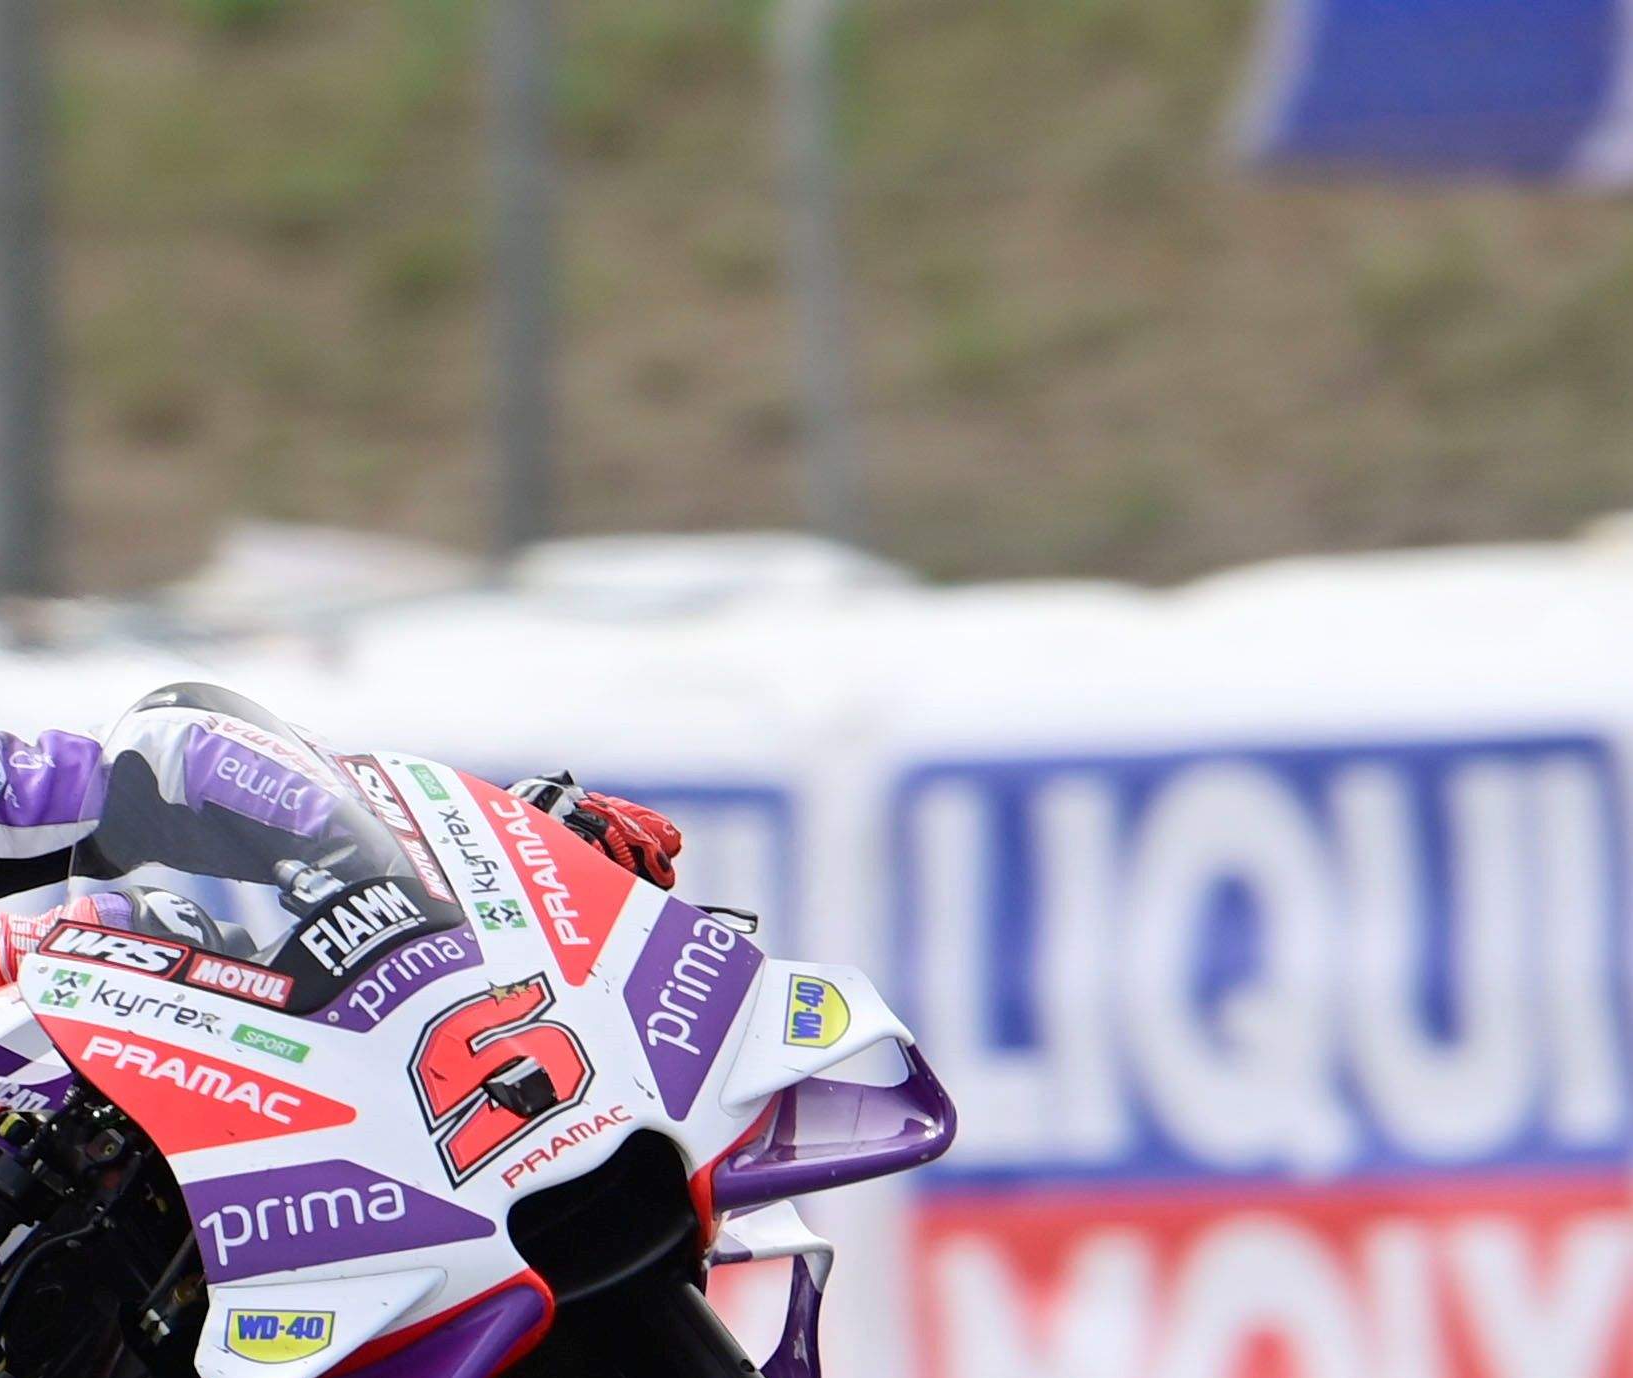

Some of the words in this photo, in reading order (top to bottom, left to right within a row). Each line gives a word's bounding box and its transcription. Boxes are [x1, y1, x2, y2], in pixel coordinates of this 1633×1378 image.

[216, 756, 310, 811] prima
[487, 800, 590, 946] PRAMAC
[49, 928, 182, 972] WRS
[299, 881, 421, 970] FIAMM
[928, 748, 1626, 1176] LIQUI
[90, 979, 222, 1034] kyrrex
[191, 959, 286, 1002] MOTUL
[348, 936, 466, 1022] prima
[646, 917, 736, 1056] prima
[791, 981, 825, 1040] WD-40
[82, 1035, 302, 1125] PRAMAC
[243, 1030, 301, 1057] SPORT
[407, 971, 596, 1190] 5
[500, 1105, 633, 1188] PRAMAC
[200, 1181, 406, 1266] prima
[237, 1315, 325, 1341] WD-40
